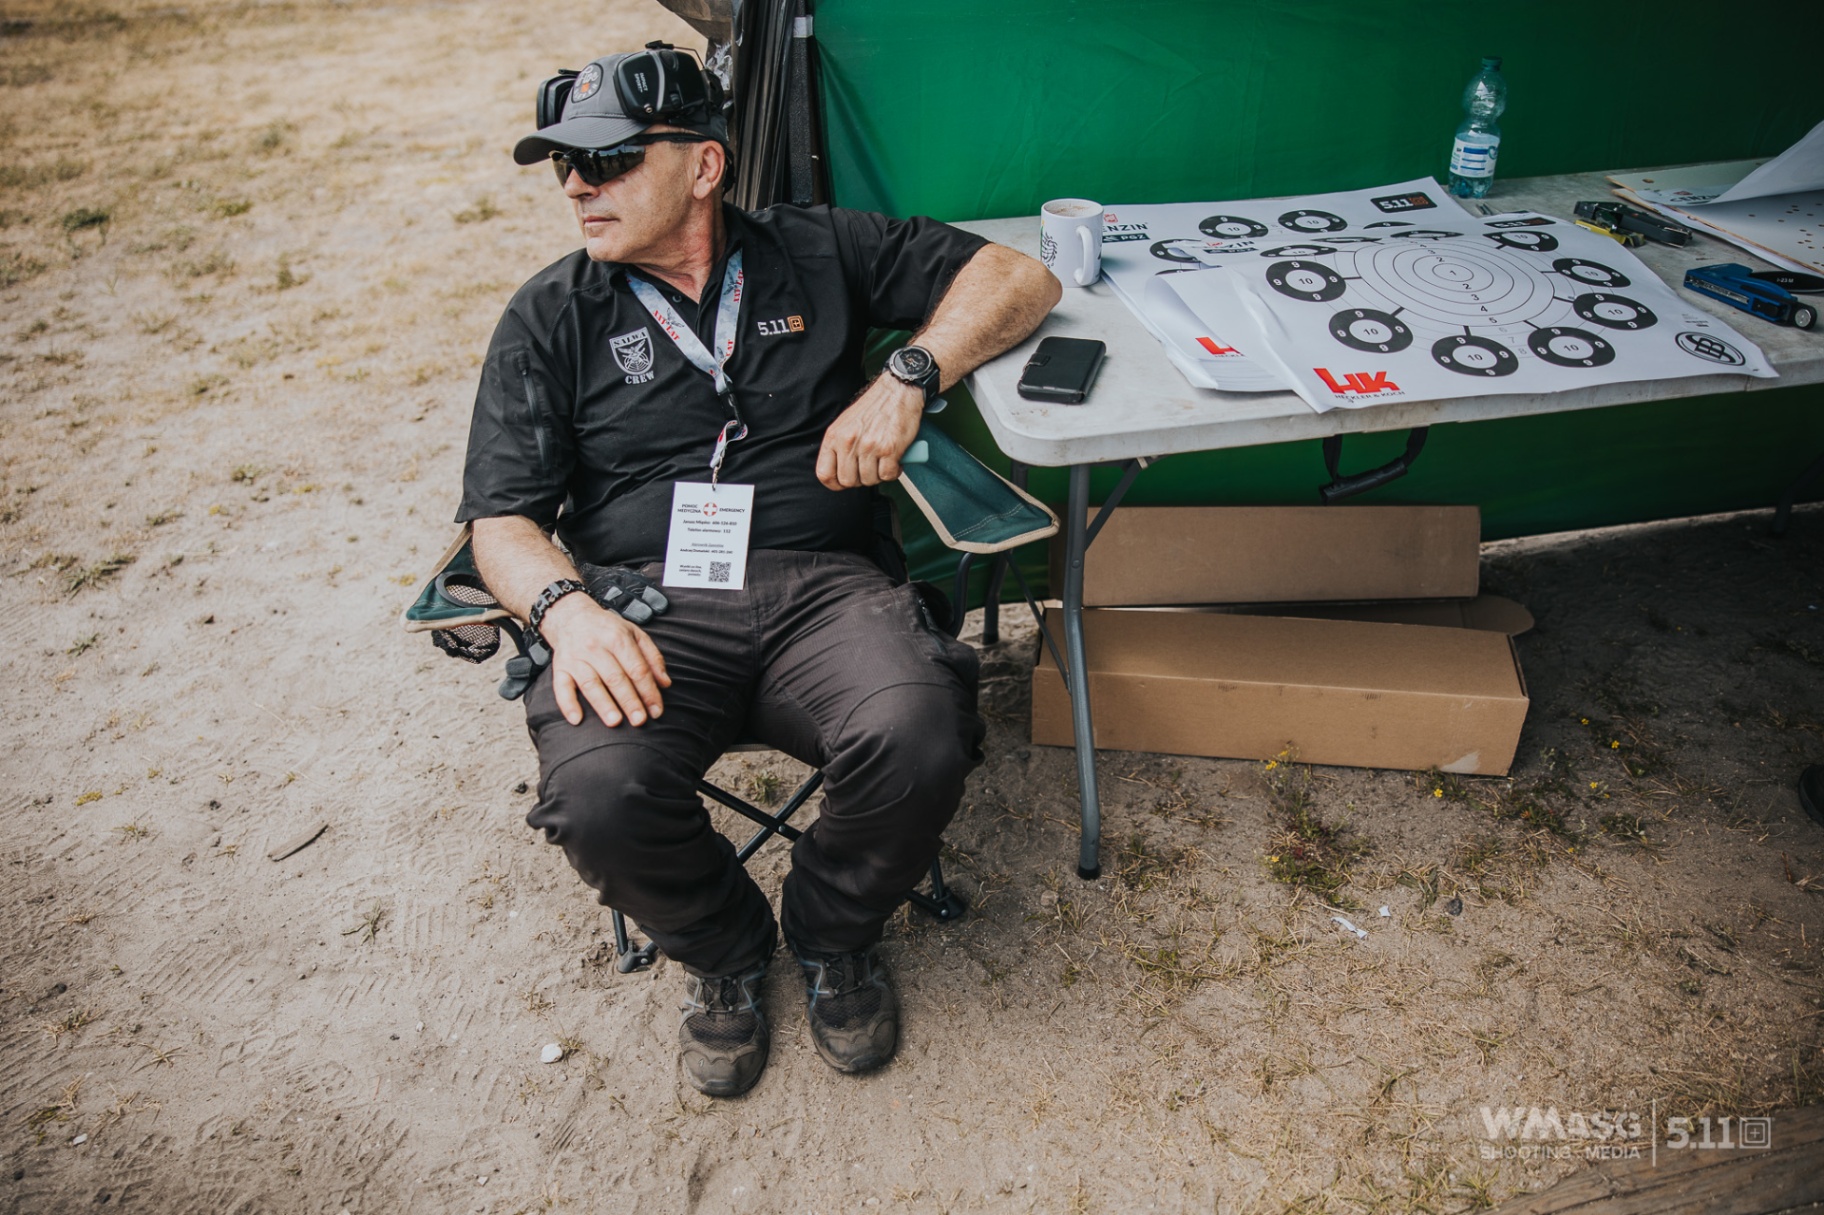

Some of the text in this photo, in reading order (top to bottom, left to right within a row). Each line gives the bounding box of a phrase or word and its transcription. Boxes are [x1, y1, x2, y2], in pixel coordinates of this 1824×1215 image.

[1379, 198, 1414, 209] 5.11
[1102, 224, 1149, 232] ENZIN
[1273, 278, 1282, 286] 9
[1329, 275, 1338, 283] 9
[1470, 293, 1480, 301] 3
[1607, 308, 1623, 316] 10
[757, 319, 790, 336] 5.11
[666, 325, 680, 341] LAT
[1363, 328, 1379, 336] 10
[1563, 344, 1579, 352] 10
[625, 370, 655, 384] CREW
